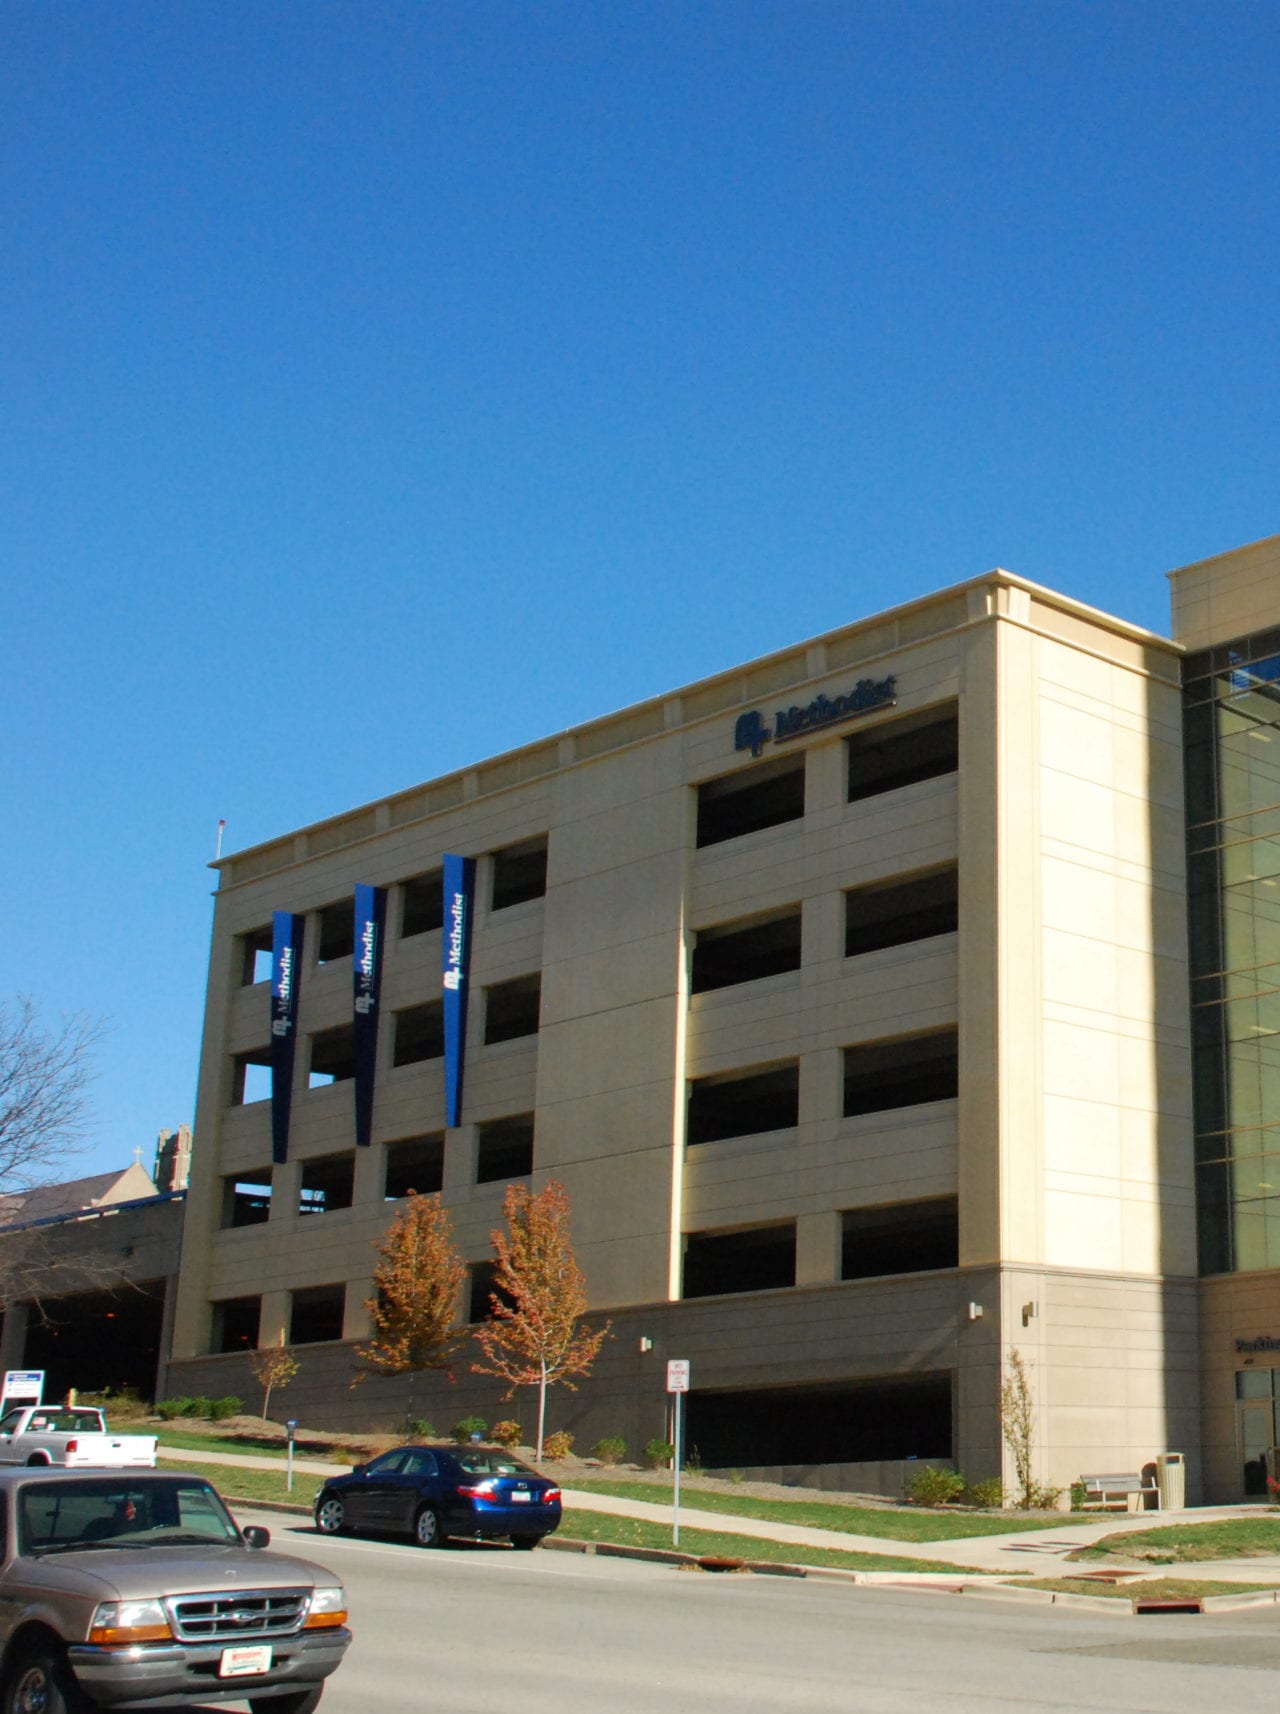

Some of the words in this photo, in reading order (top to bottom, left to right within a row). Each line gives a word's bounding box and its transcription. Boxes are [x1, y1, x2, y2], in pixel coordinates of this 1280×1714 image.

[775, 675, 896, 736] Methodist
[361, 921, 375, 990] Methodist
[448, 892, 465, 965] Methodist
[276, 946, 293, 1013] Methodist
